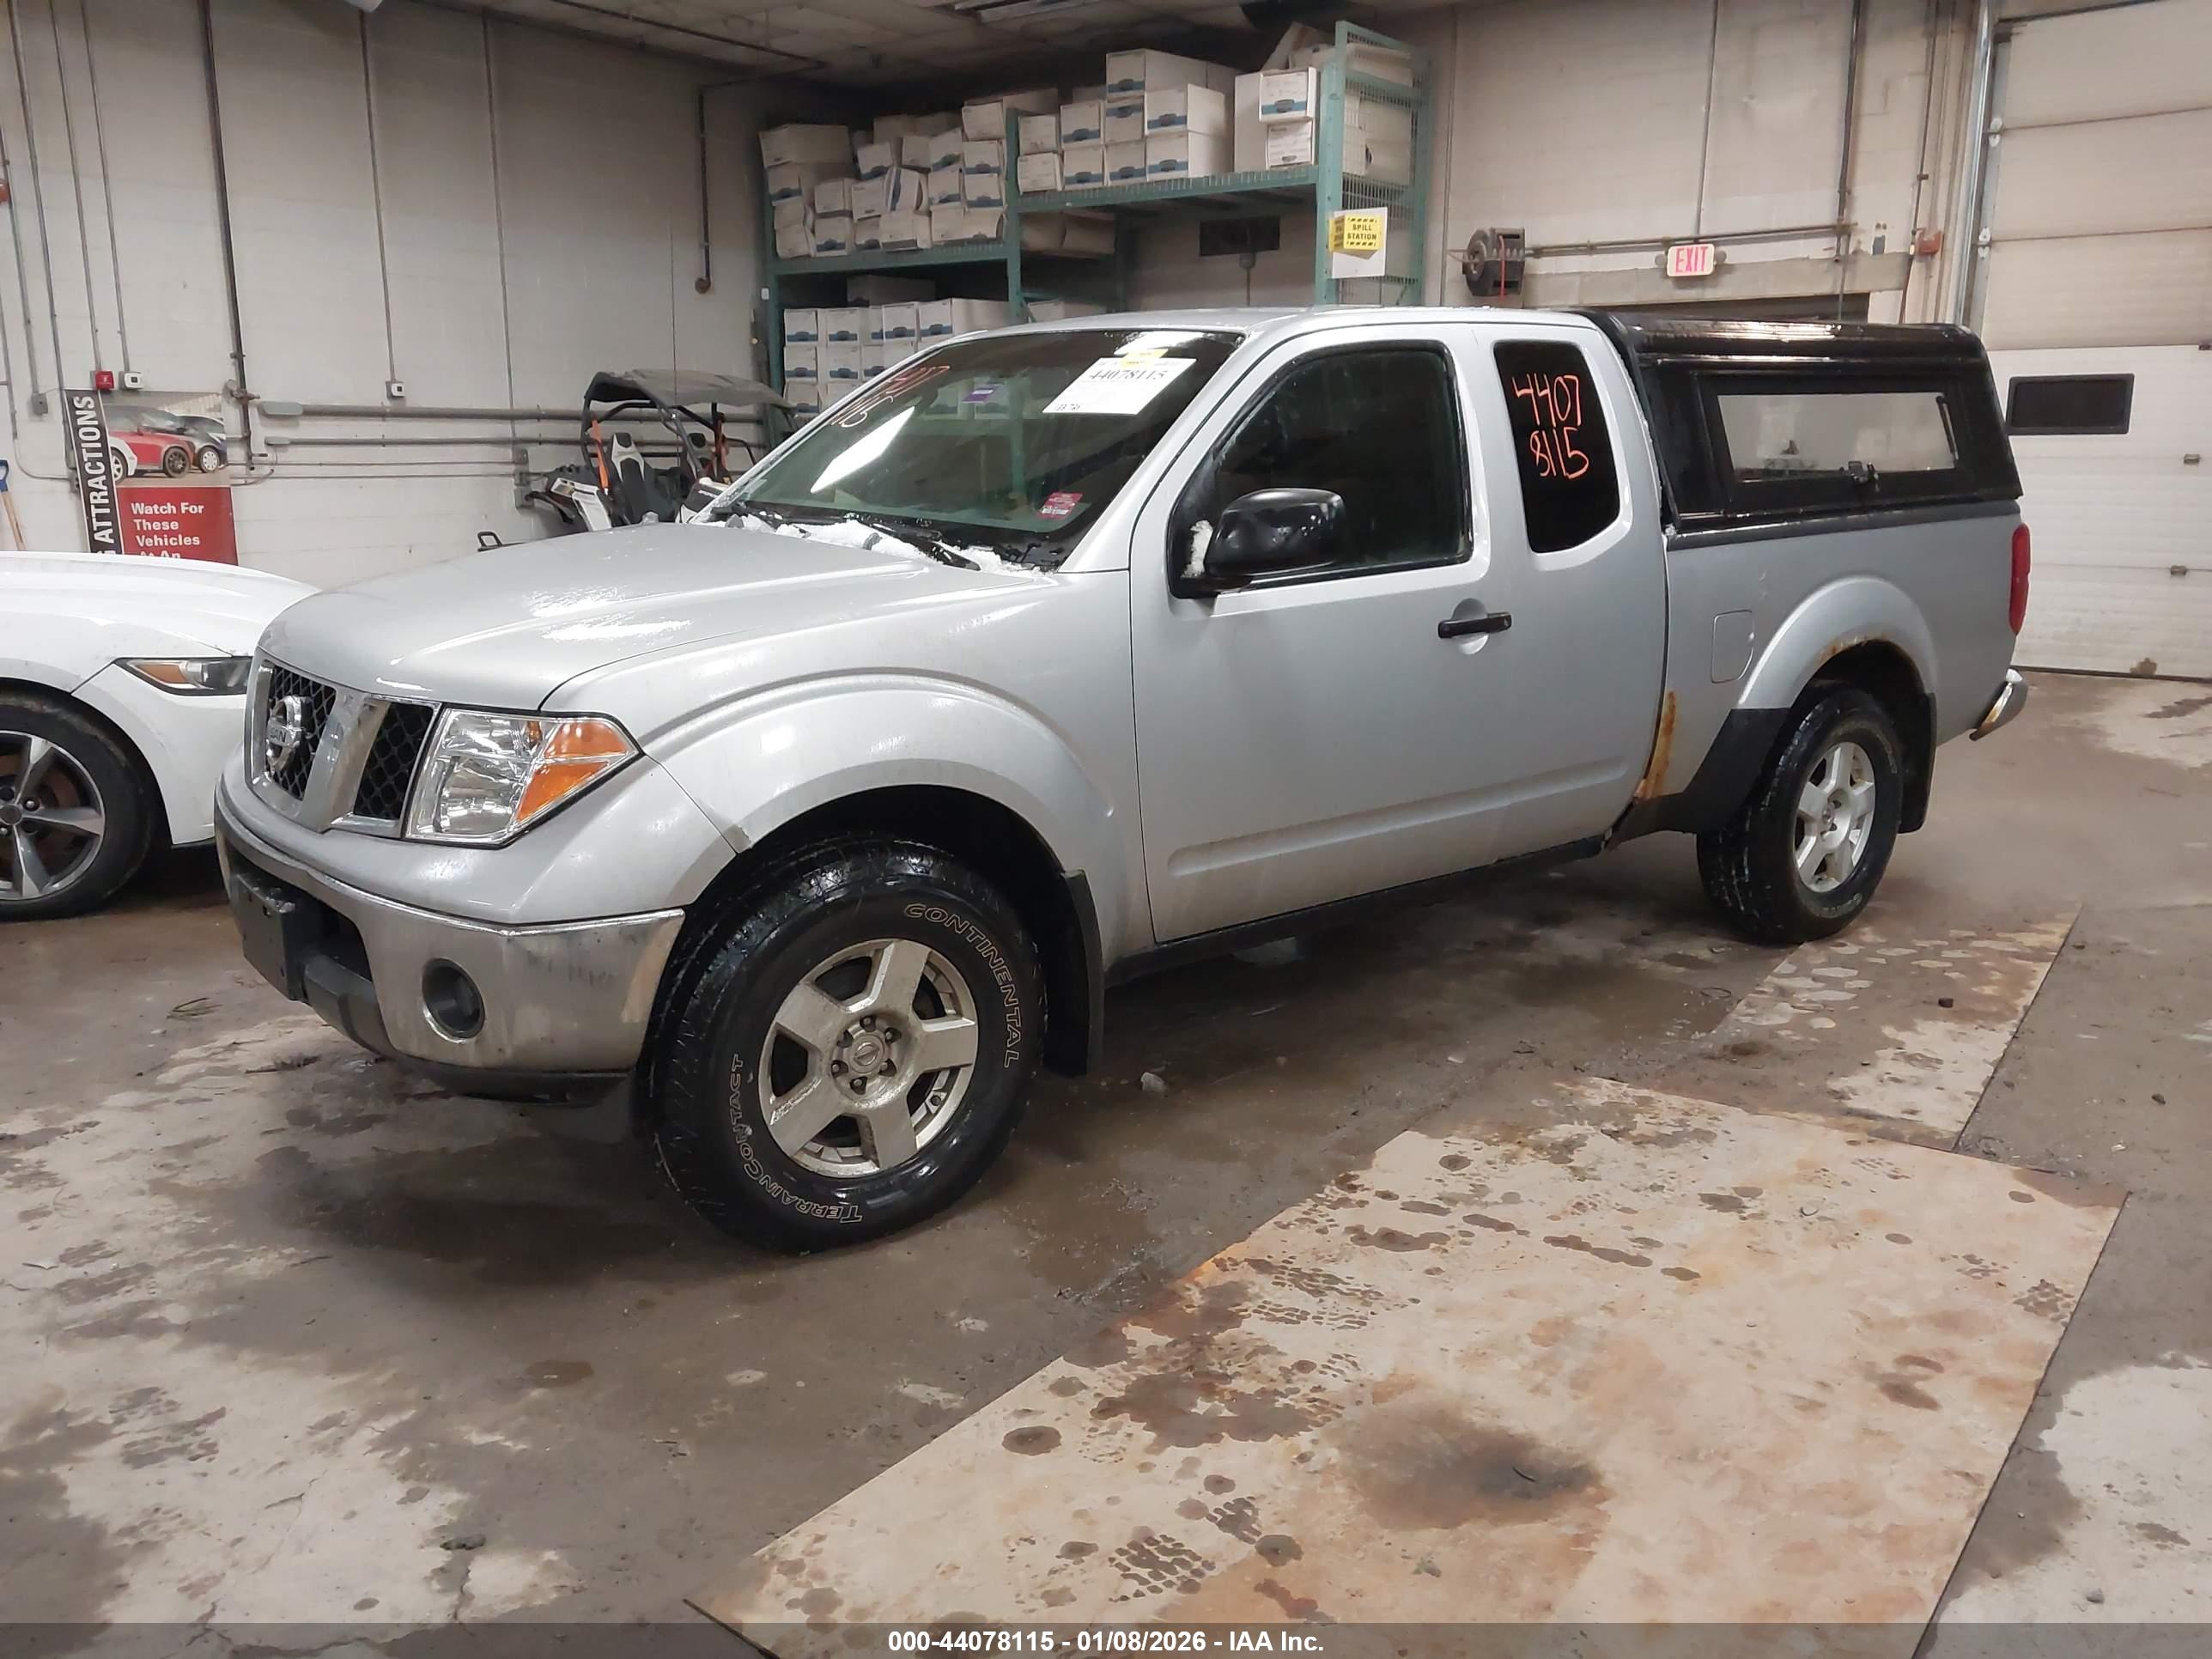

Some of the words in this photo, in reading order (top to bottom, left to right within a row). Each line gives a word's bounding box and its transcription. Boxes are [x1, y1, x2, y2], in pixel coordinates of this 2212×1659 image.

[1352, 223, 1373, 232] SPILL
[1346, 232, 1377, 240] STATION
[1675, 246, 1709, 273] EXIT
[1089, 368, 1169, 380] 44078115
[1512, 373, 1582, 428] 4407
[1529, 427, 1589, 480] 8115
[73, 395, 115, 544] ATTRACTIONS
[131, 501, 177, 514] Watch
[180, 502, 204, 514] For
[133, 519, 179, 531] These
[136, 534, 200, 547] Vehicles
[903, 902, 1022, 1068] CONTINENTAL
